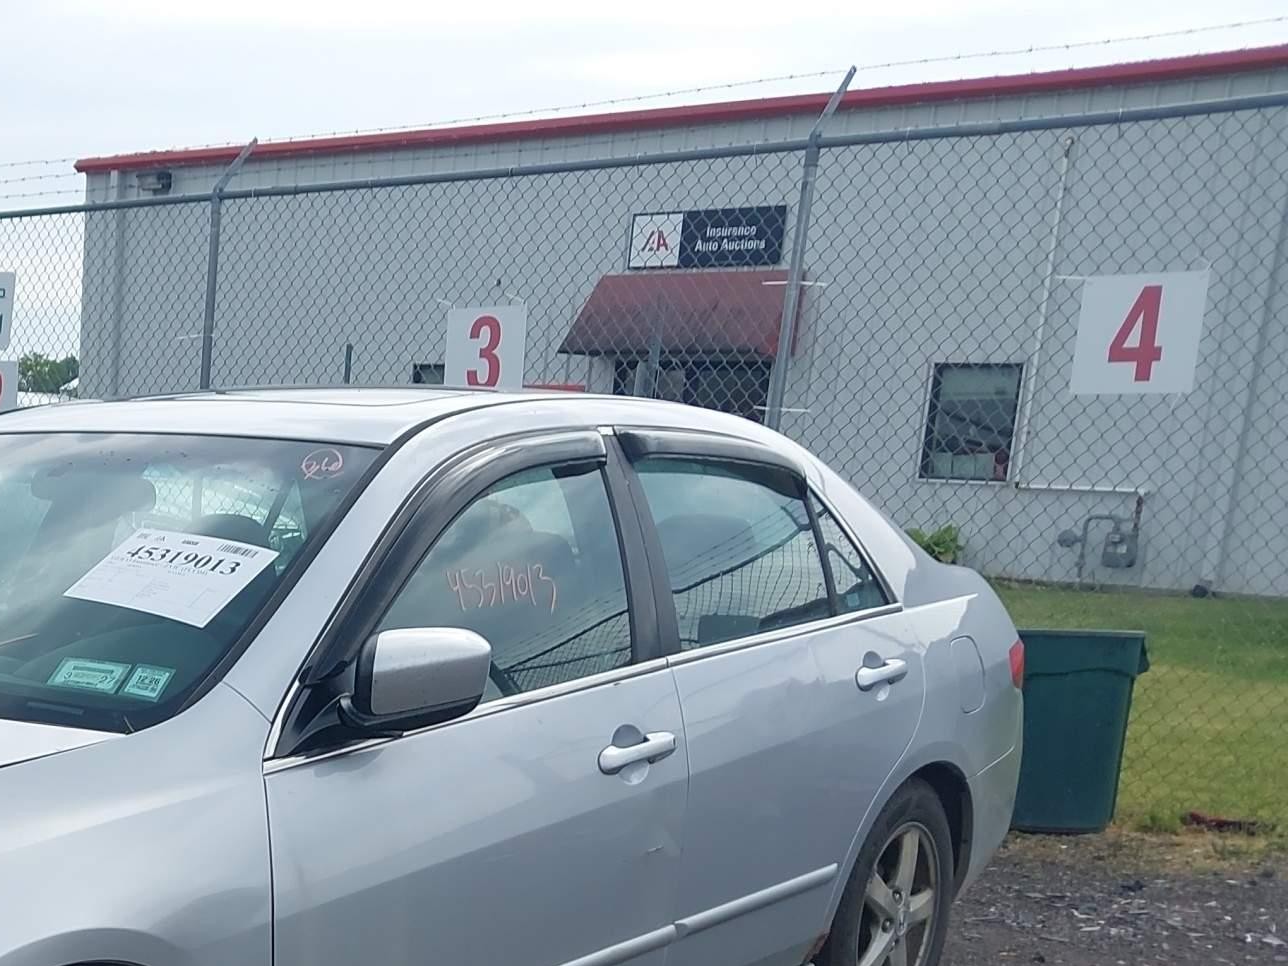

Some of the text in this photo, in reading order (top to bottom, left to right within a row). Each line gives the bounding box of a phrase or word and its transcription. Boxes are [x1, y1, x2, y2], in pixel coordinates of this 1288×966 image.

[694, 237, 766, 252] Auto Auctions
[706, 225, 757, 238] Insurance
[466, 315, 501, 388] 3
[1107, 285, 1163, 382] 4
[126, 544, 241, 576] 45319013
[445, 561, 557, 616] 45319013
